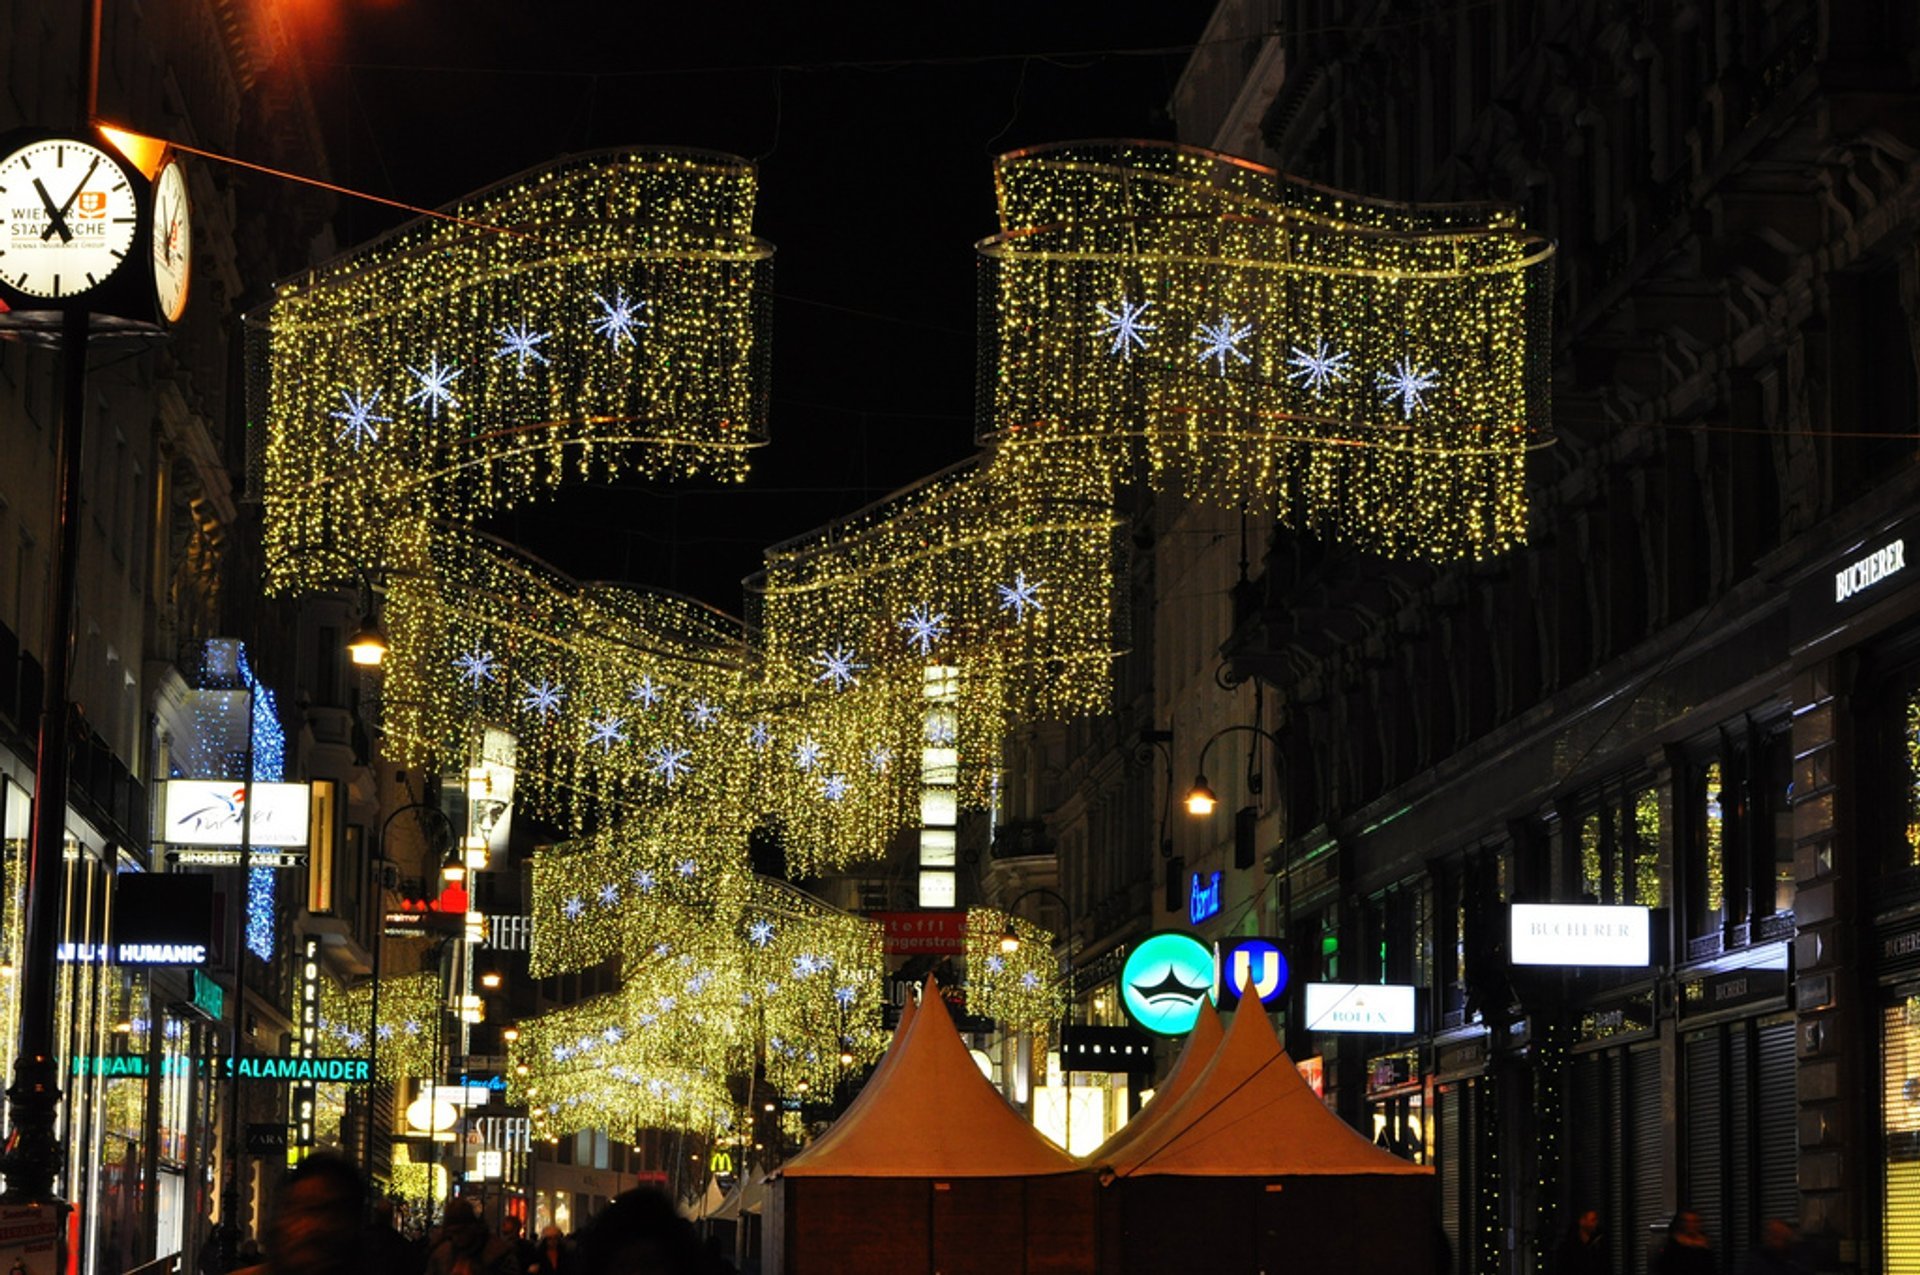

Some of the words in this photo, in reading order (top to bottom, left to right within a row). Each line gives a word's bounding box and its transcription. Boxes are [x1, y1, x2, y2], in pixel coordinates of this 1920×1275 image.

[1836, 538, 1905, 602] BUCHERER
[178, 853, 281, 865] SINGERSTASSE
[1531, 922, 1630, 937] BUCHERER
[119, 944, 206, 963] HUMANIC
[1233, 950, 1279, 999] U
[1333, 1011, 1387, 1023] ROLEX
